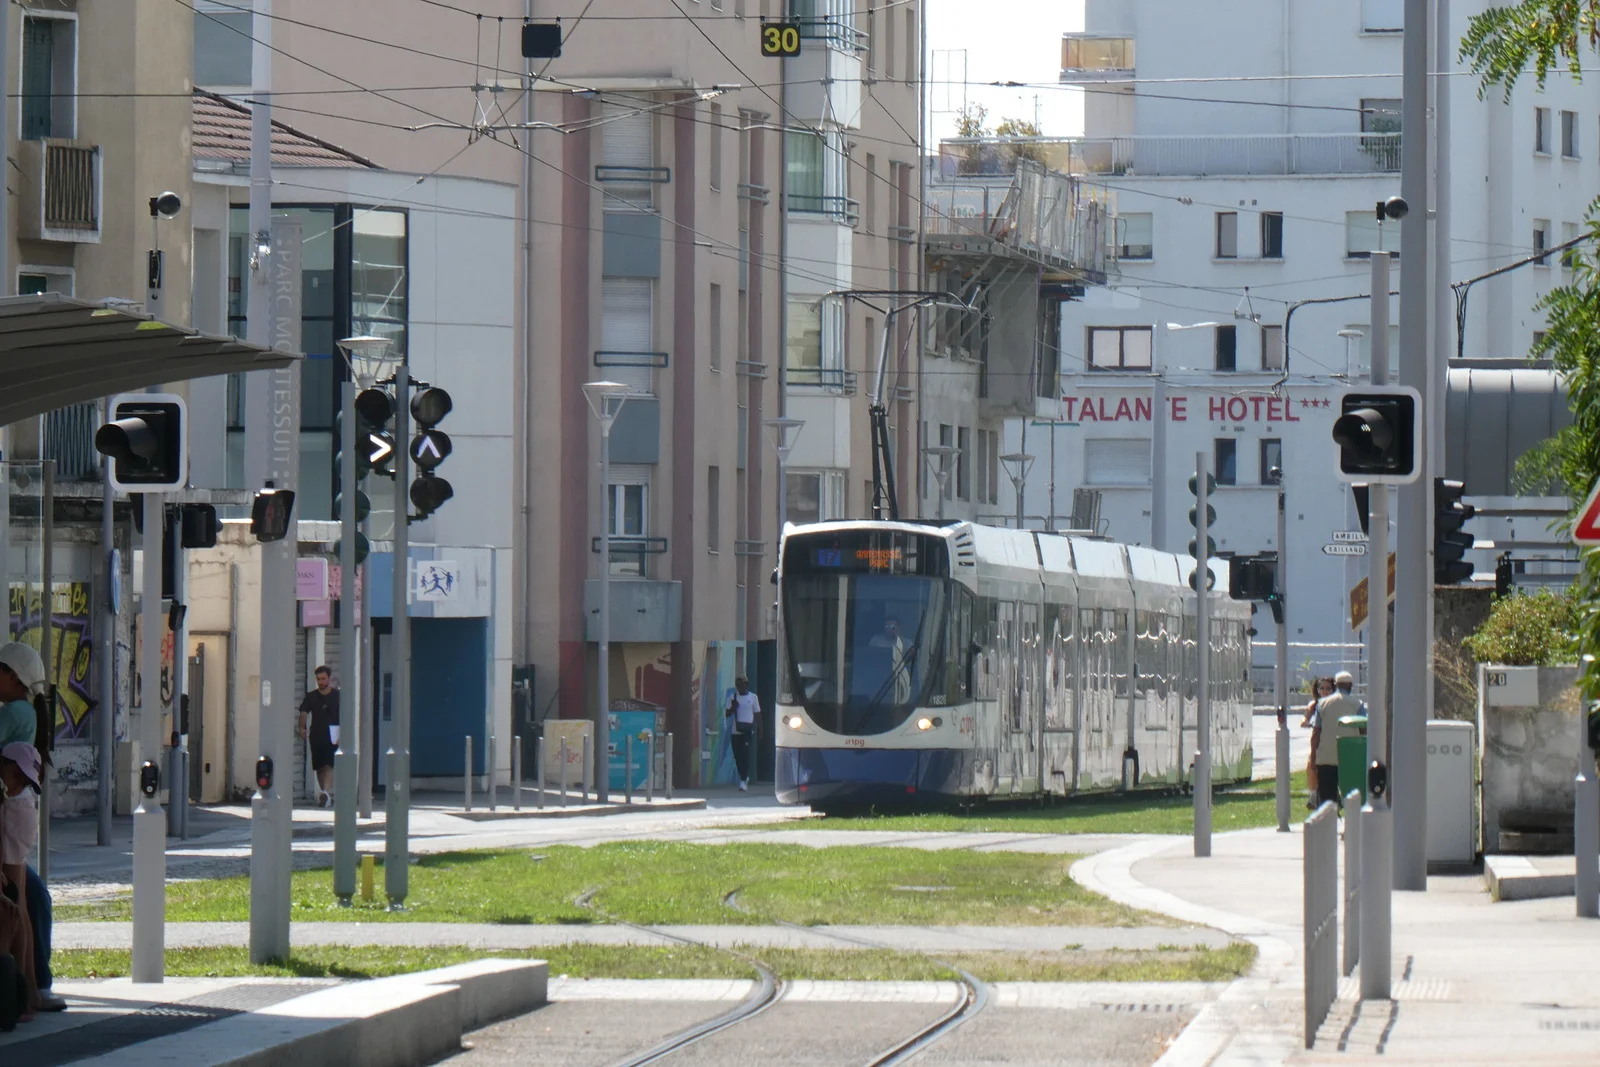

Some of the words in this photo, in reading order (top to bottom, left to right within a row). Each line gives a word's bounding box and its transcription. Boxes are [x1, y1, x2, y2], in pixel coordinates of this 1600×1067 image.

[764, 27, 799, 53] 30
[277, 250, 293, 309] PARC
[273, 317, 293, 465] MOTESSUIT
[1060, 397, 1187, 421] TALANE
[1208, 397, 1300, 421] HOTEL
[1489, 673, 1504, 685] 20
